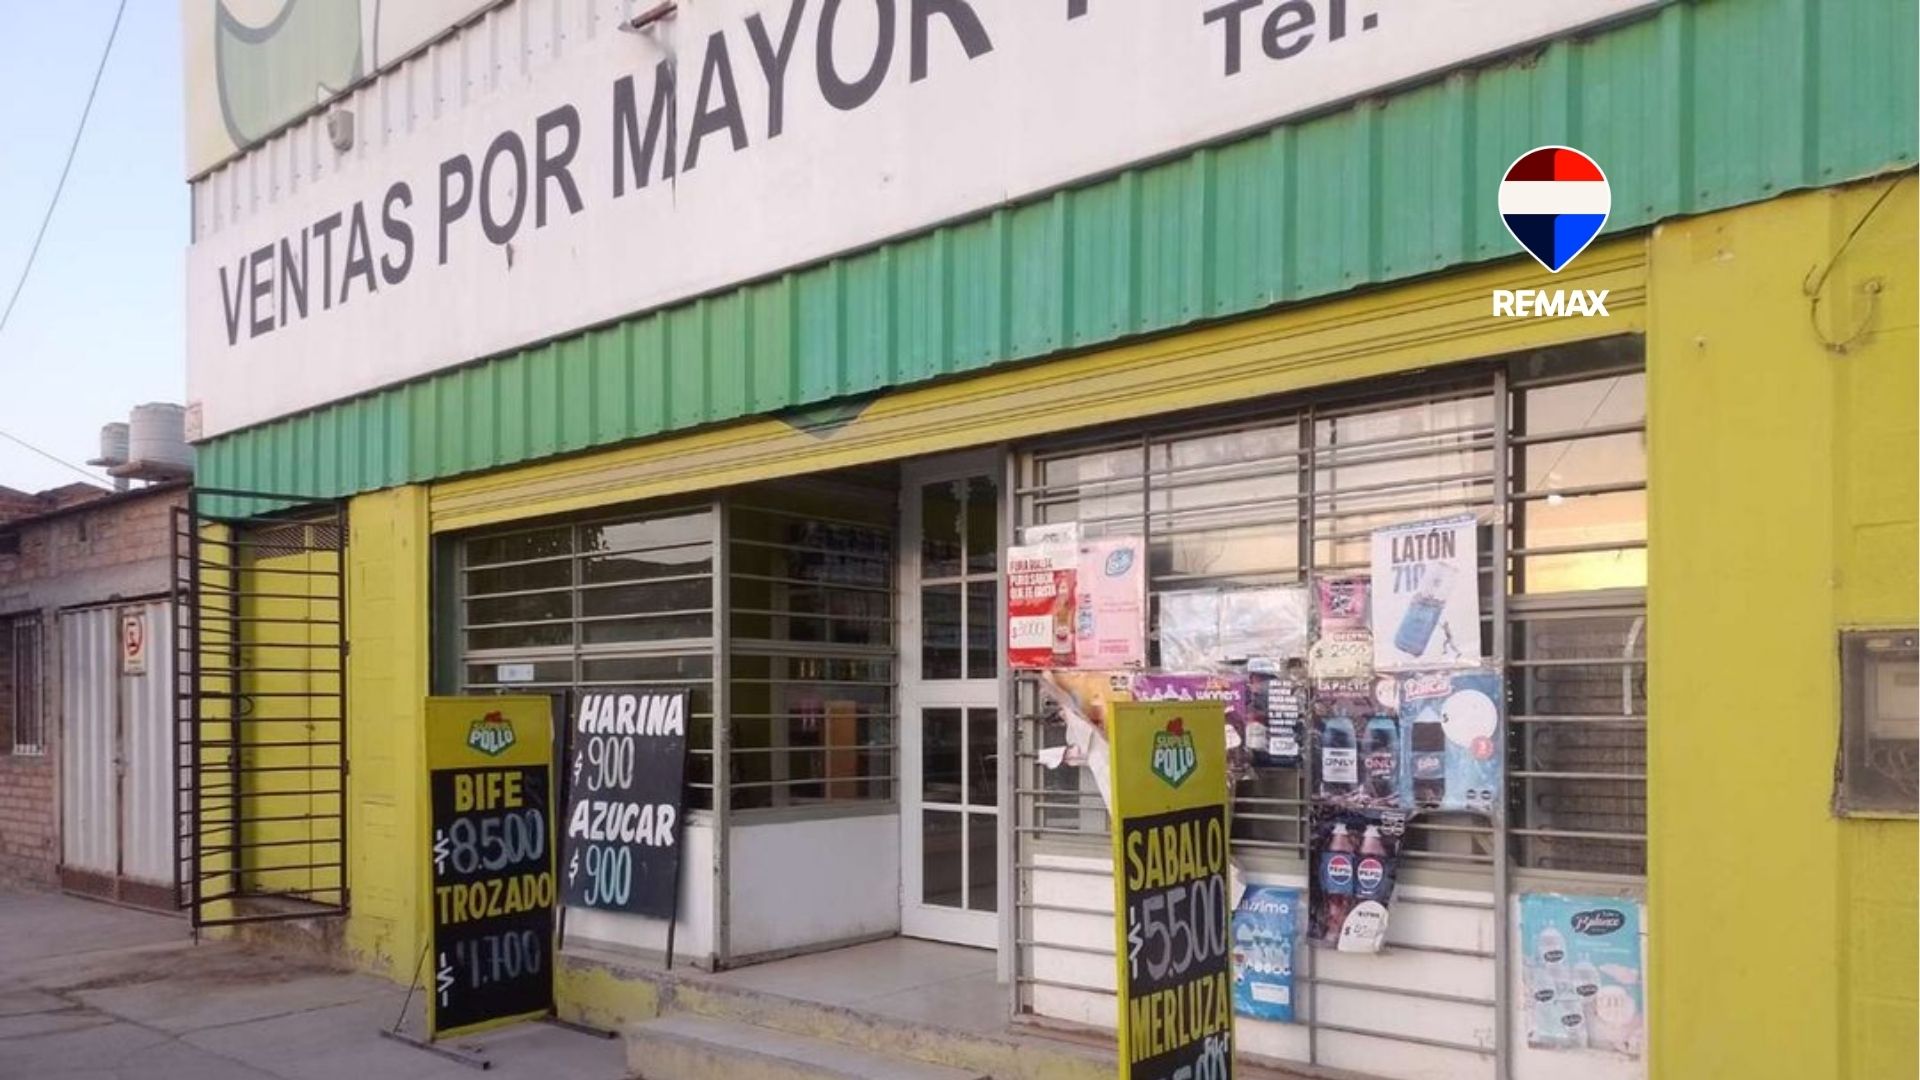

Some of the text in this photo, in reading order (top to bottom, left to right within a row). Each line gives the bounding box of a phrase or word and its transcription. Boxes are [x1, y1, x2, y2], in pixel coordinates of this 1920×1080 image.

[219, 181, 415, 346] VENTAS
[438, 104, 584, 265] POR
[1391, 528, 1456, 564] LATÓN
[579, 694, 685, 736] HARINA
[469, 729, 514, 753] POLLO
[1153, 746, 1195, 782] POLLO
[455, 771, 523, 812] BIFE
[568, 799, 677, 847] AZUCAR
[1127, 817, 1223, 891] SABALO
[437, 872, 551, 924] TROZADO
[1131, 971, 1230, 1063] MERLUZA
